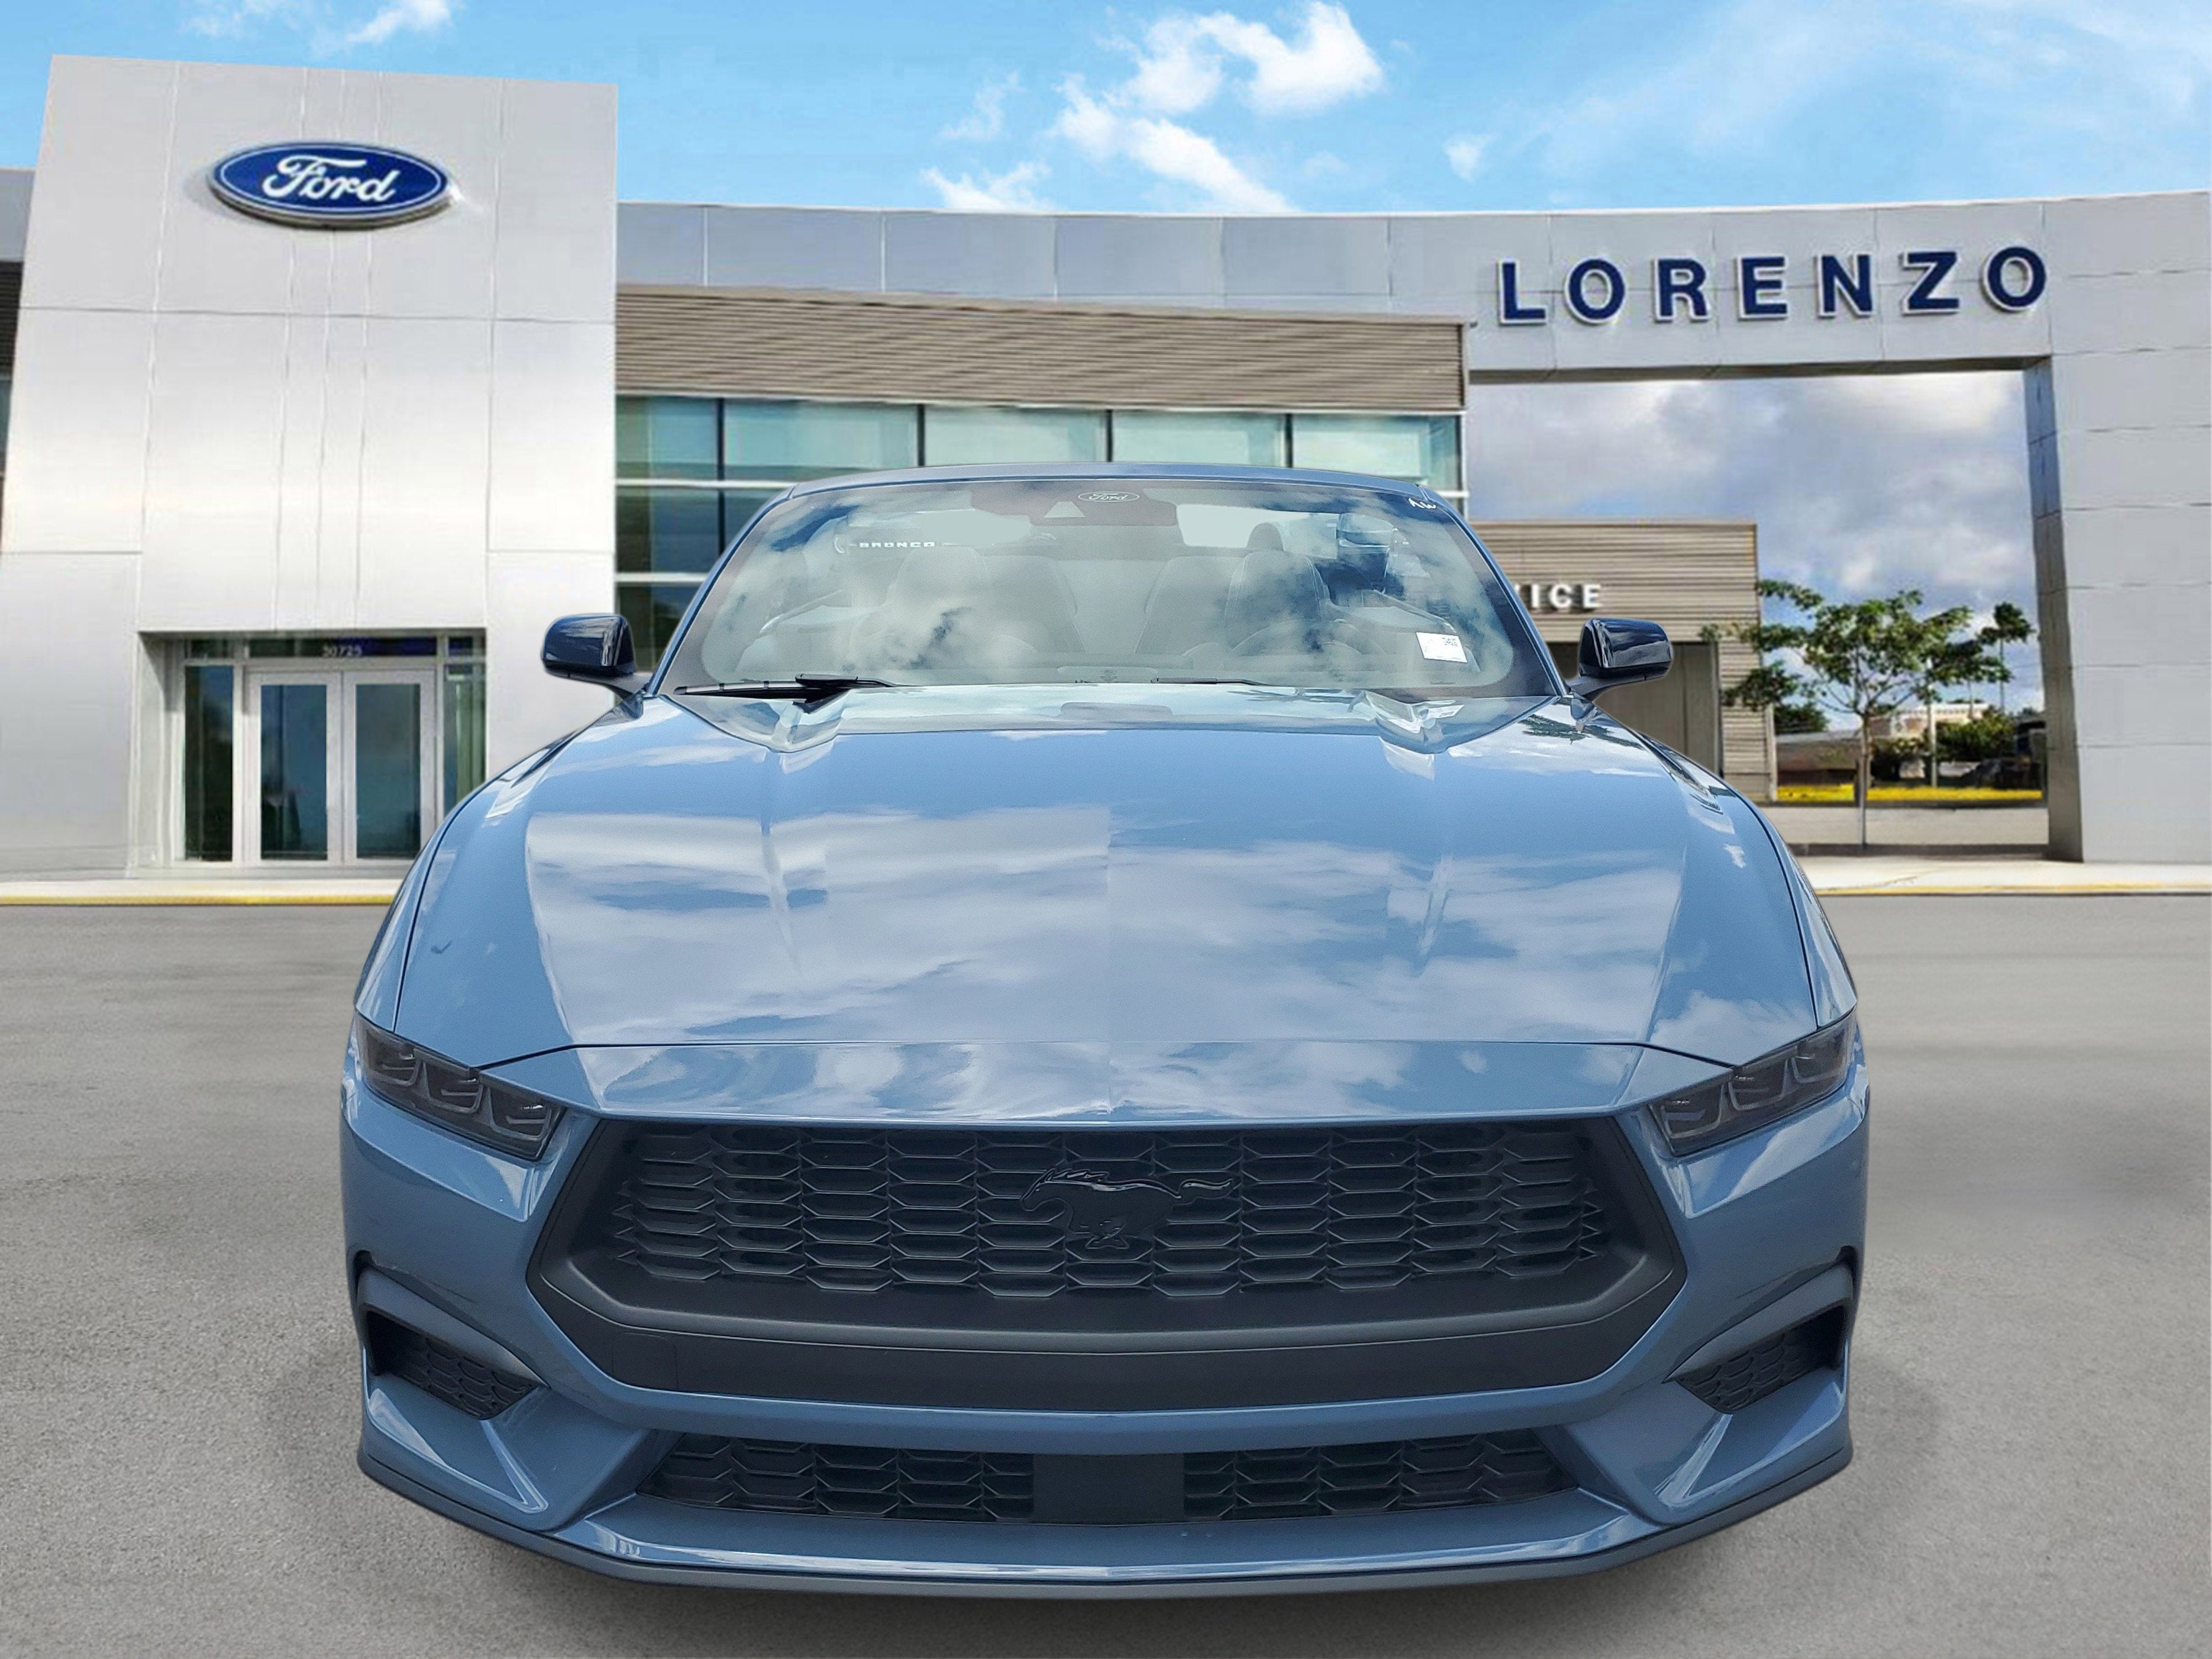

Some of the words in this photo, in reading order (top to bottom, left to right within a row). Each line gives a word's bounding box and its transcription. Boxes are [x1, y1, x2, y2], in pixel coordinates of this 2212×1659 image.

[263, 154, 401, 202] Ford
[1498, 246, 2046, 324] LORENZO
[1515, 583, 1602, 608] ICE
